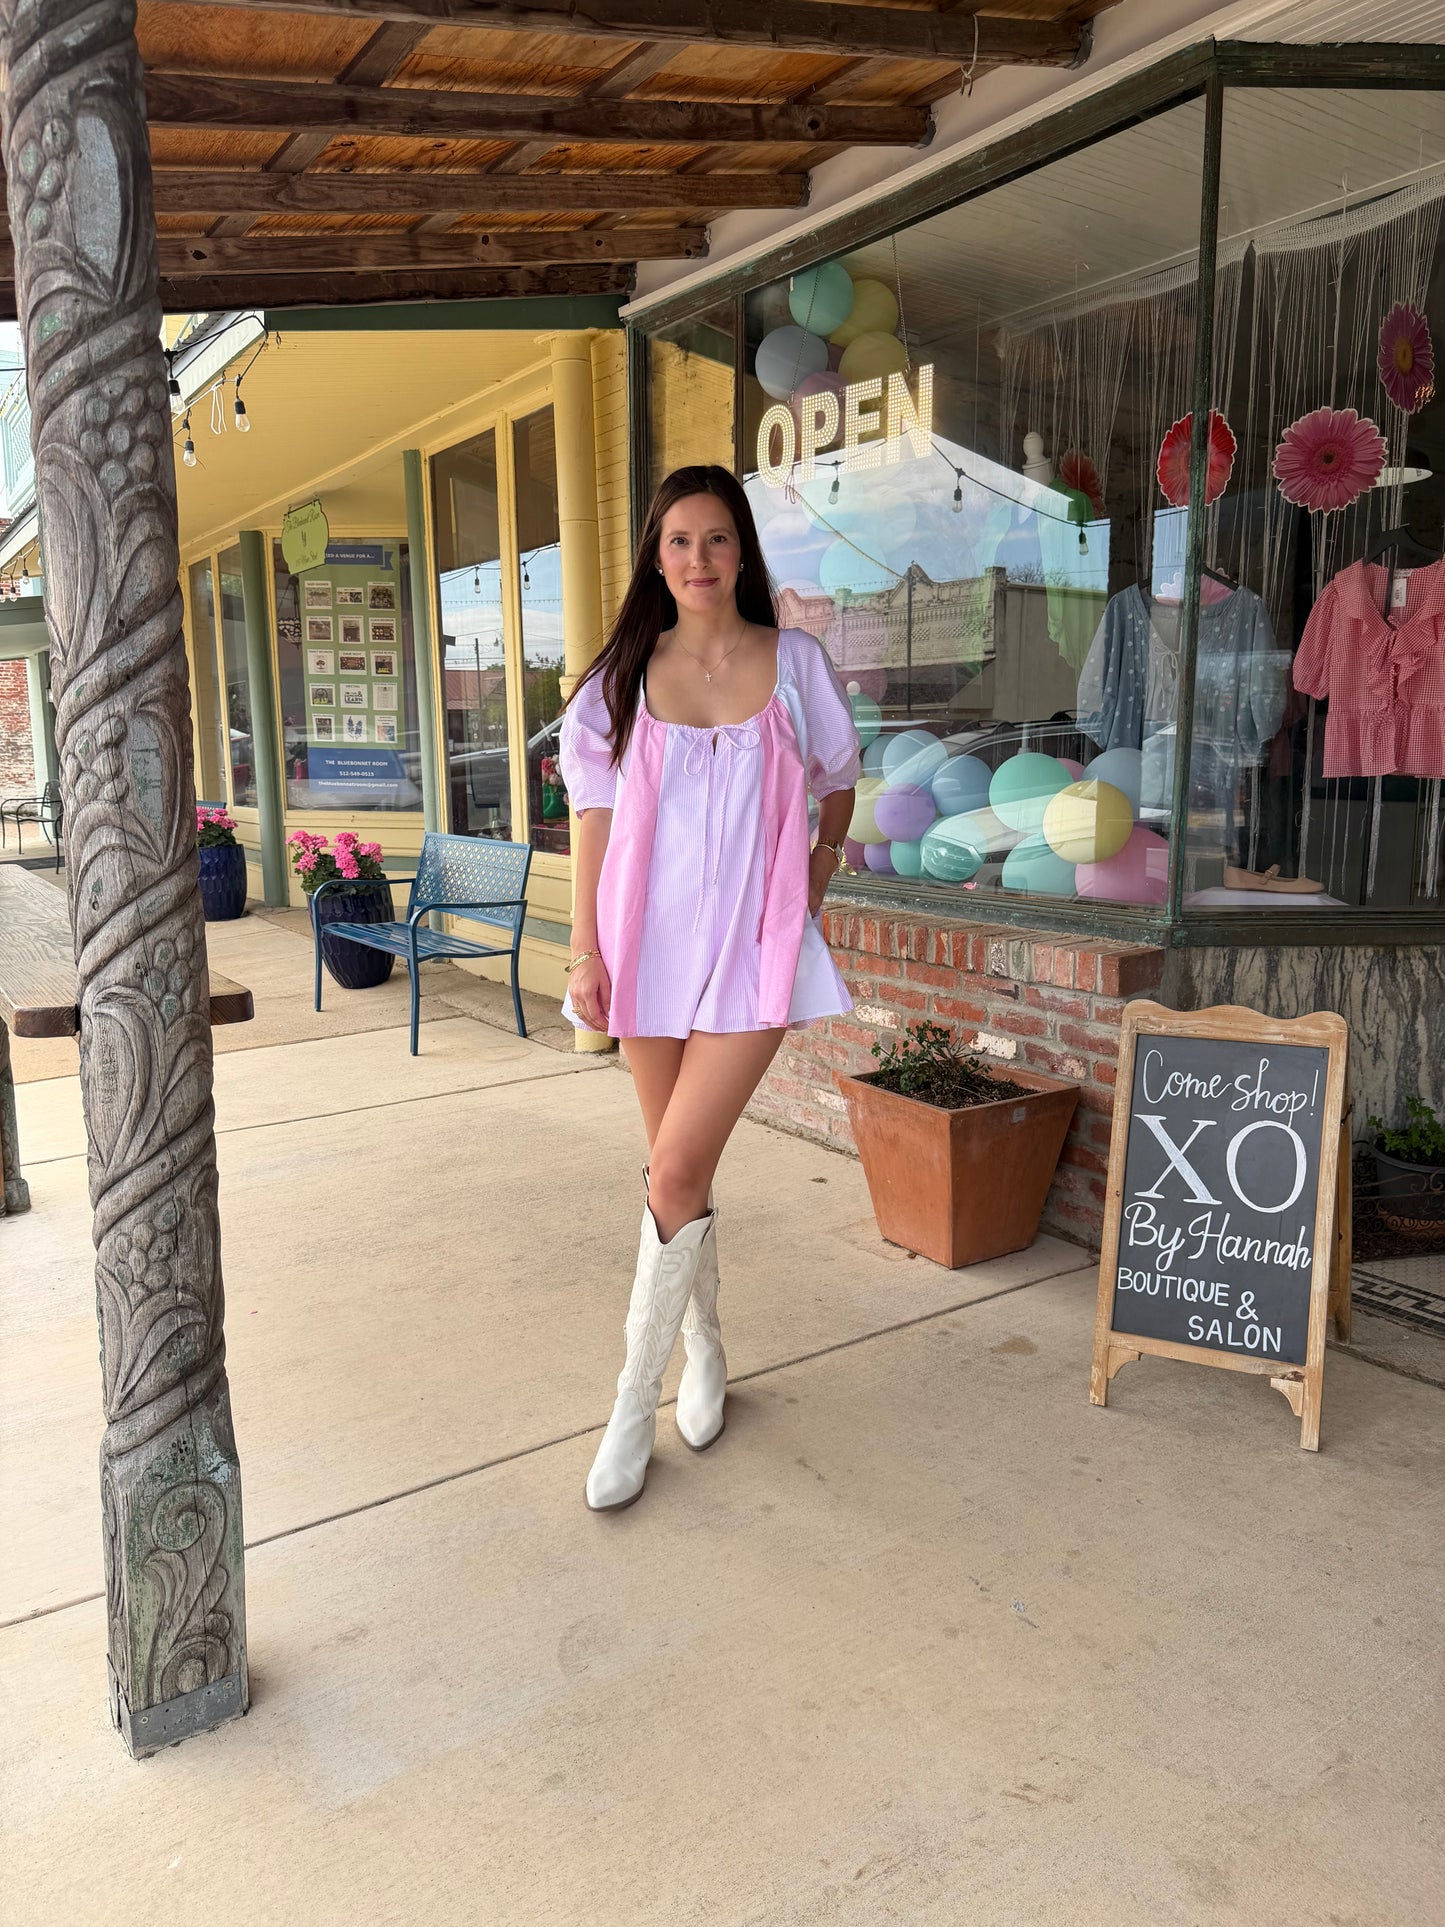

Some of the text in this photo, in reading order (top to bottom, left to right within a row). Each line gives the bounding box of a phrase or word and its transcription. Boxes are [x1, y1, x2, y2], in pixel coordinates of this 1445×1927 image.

[756, 363, 935, 489] OPEN
[1143, 1050, 1230, 1104] Come
[1134, 1113, 1307, 1214] XO
[1124, 1201, 1312, 1272] By Hannah
[1117, 1267, 1259, 1321] BOUTIQUE &
[1188, 1315, 1282, 1353] SALON
